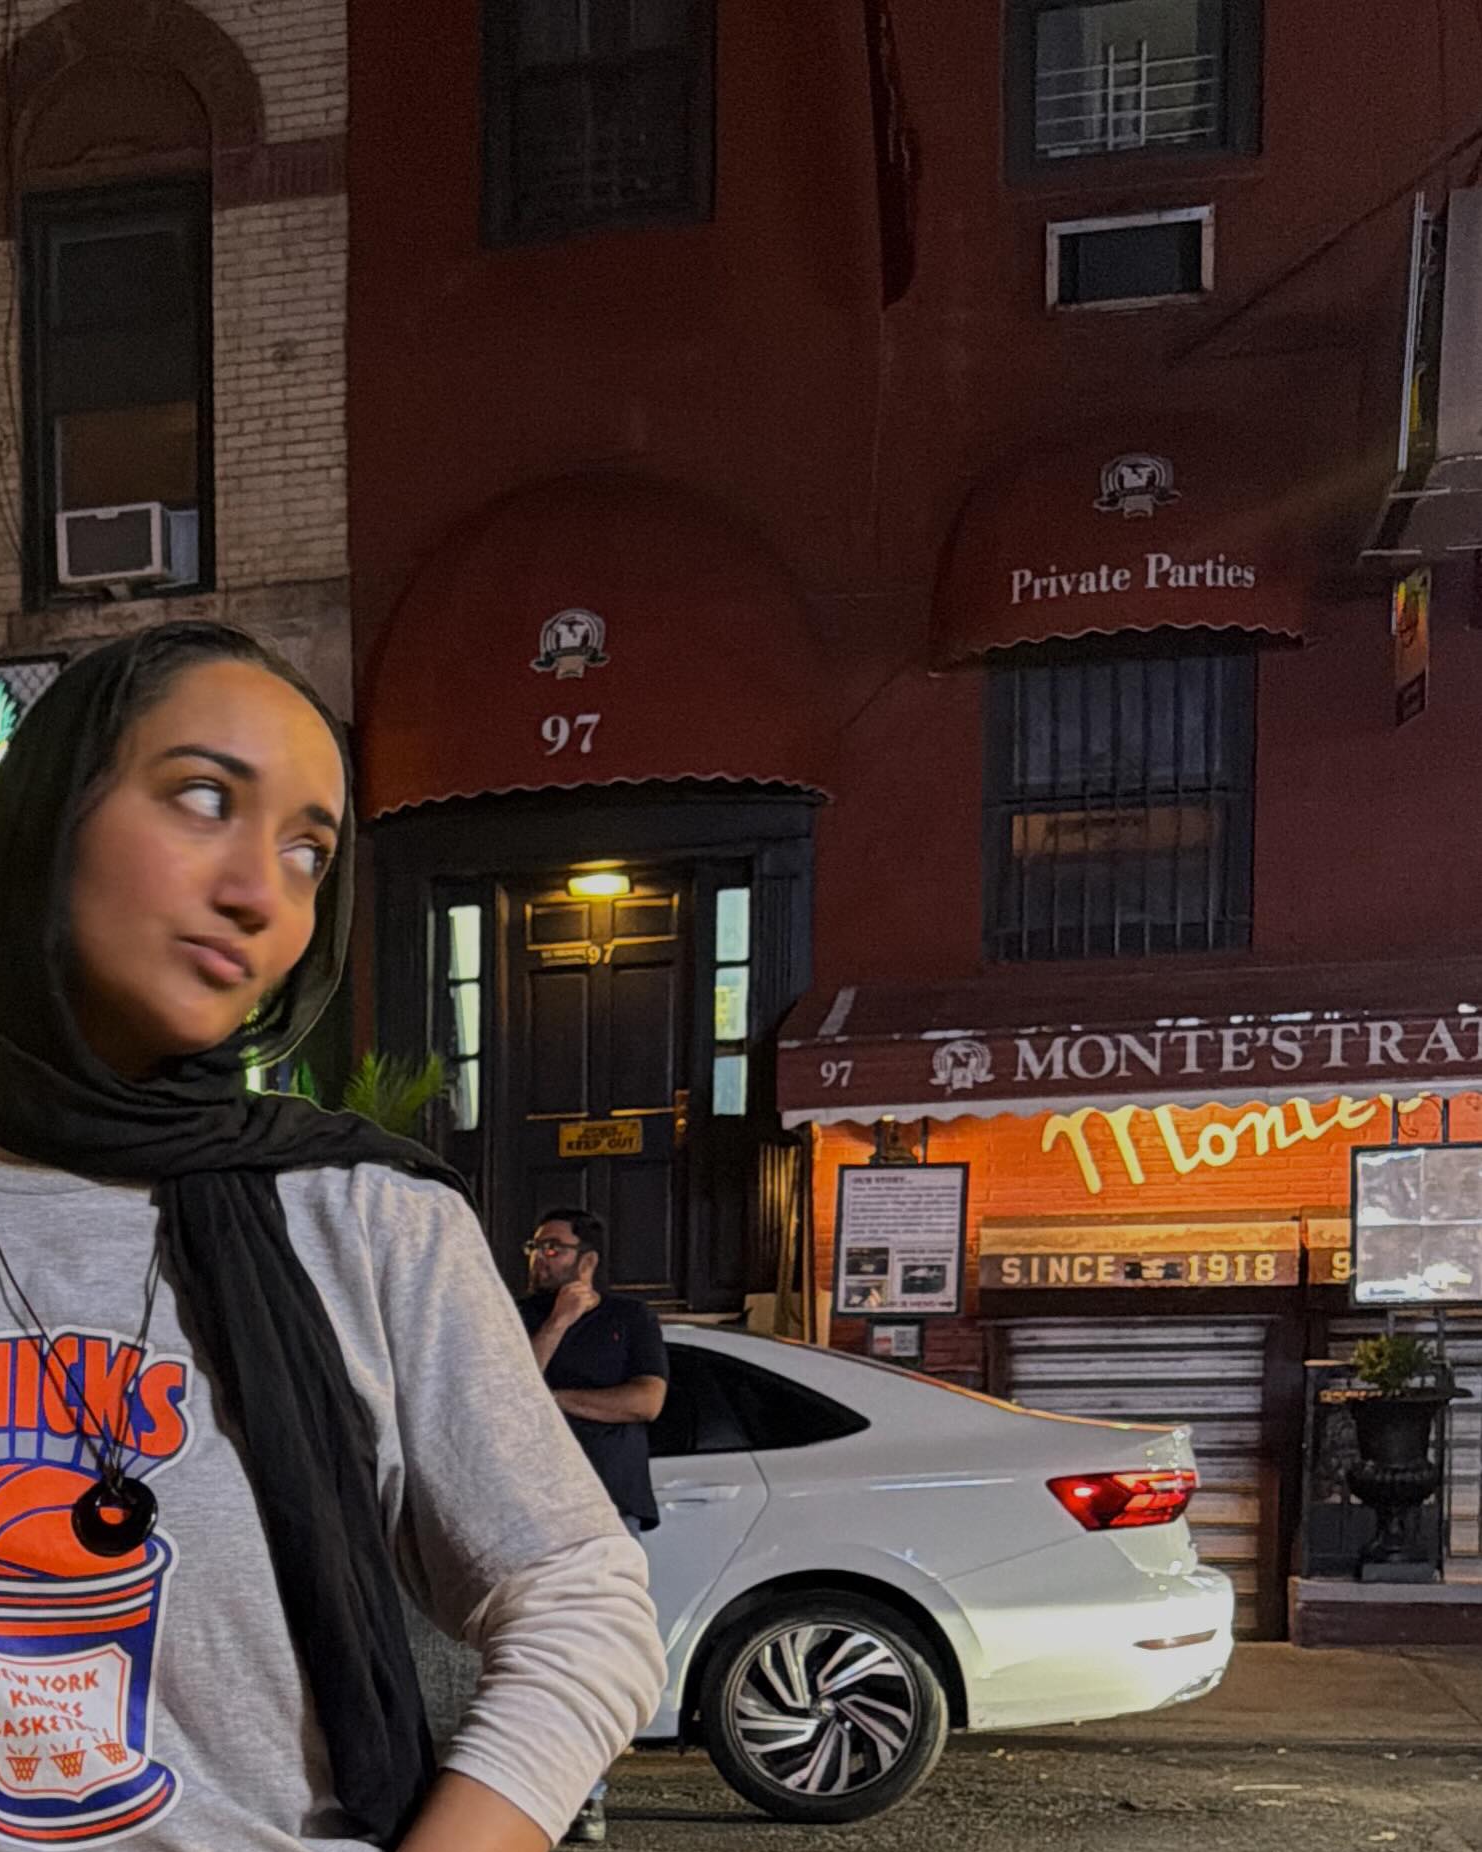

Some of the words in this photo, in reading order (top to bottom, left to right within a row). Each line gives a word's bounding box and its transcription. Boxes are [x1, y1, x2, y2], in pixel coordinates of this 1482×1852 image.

[1010, 564, 1132, 605] Private
[1144, 552, 1256, 589] Parties
[541, 713, 602, 756] 97
[588, 943, 615, 965] 97
[1012, 1026, 1304, 1082] MONTE'S
[819, 1060, 854, 1088] 97
[1001, 1256, 1115, 1285] SINCE
[1187, 1253, 1276, 1282] 1918
[35, 1668, 99, 1694] YORK
